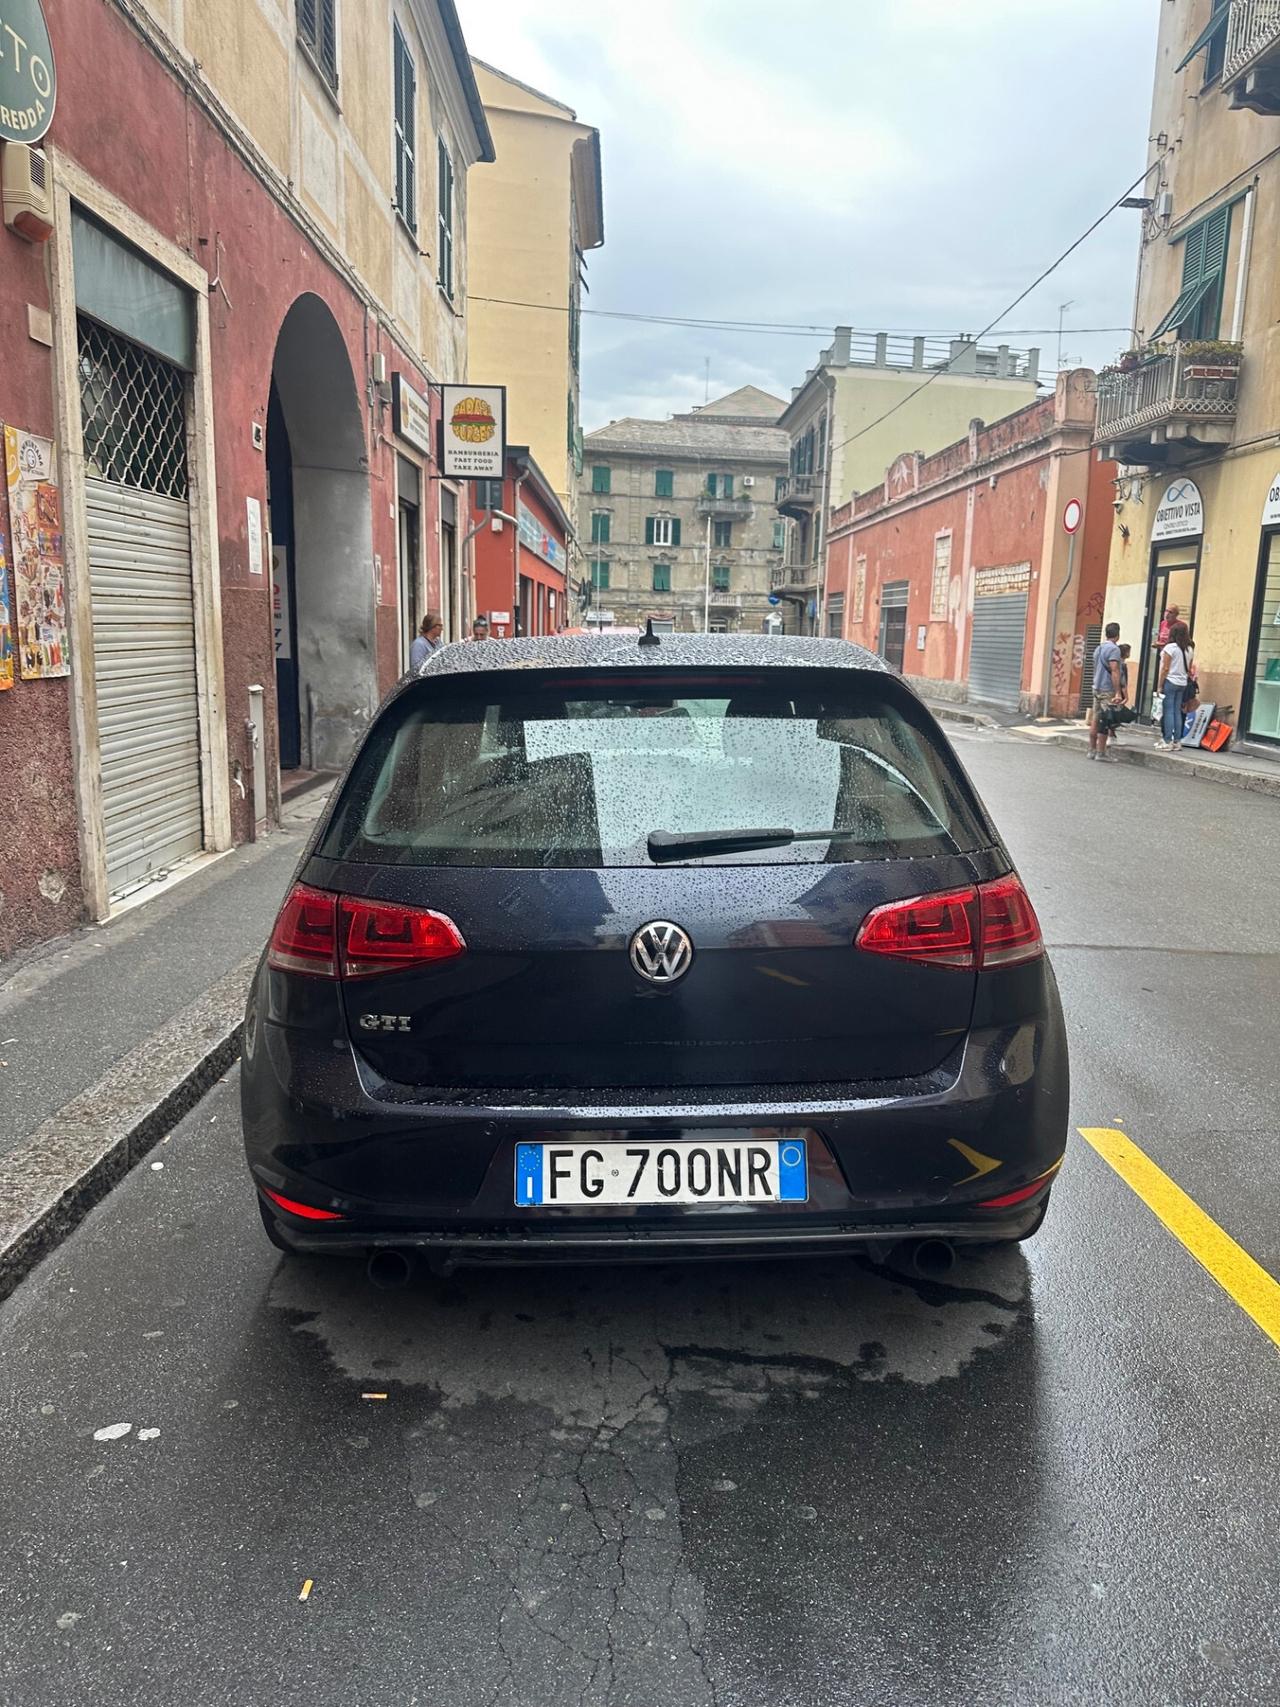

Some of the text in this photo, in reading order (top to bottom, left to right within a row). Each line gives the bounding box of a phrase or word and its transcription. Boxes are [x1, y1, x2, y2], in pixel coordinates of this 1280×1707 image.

[1156, 502, 1201, 523] OBIETTIVO VISTA
[358, 1014, 412, 1032] GTI
[549, 1149, 604, 1199] FG
